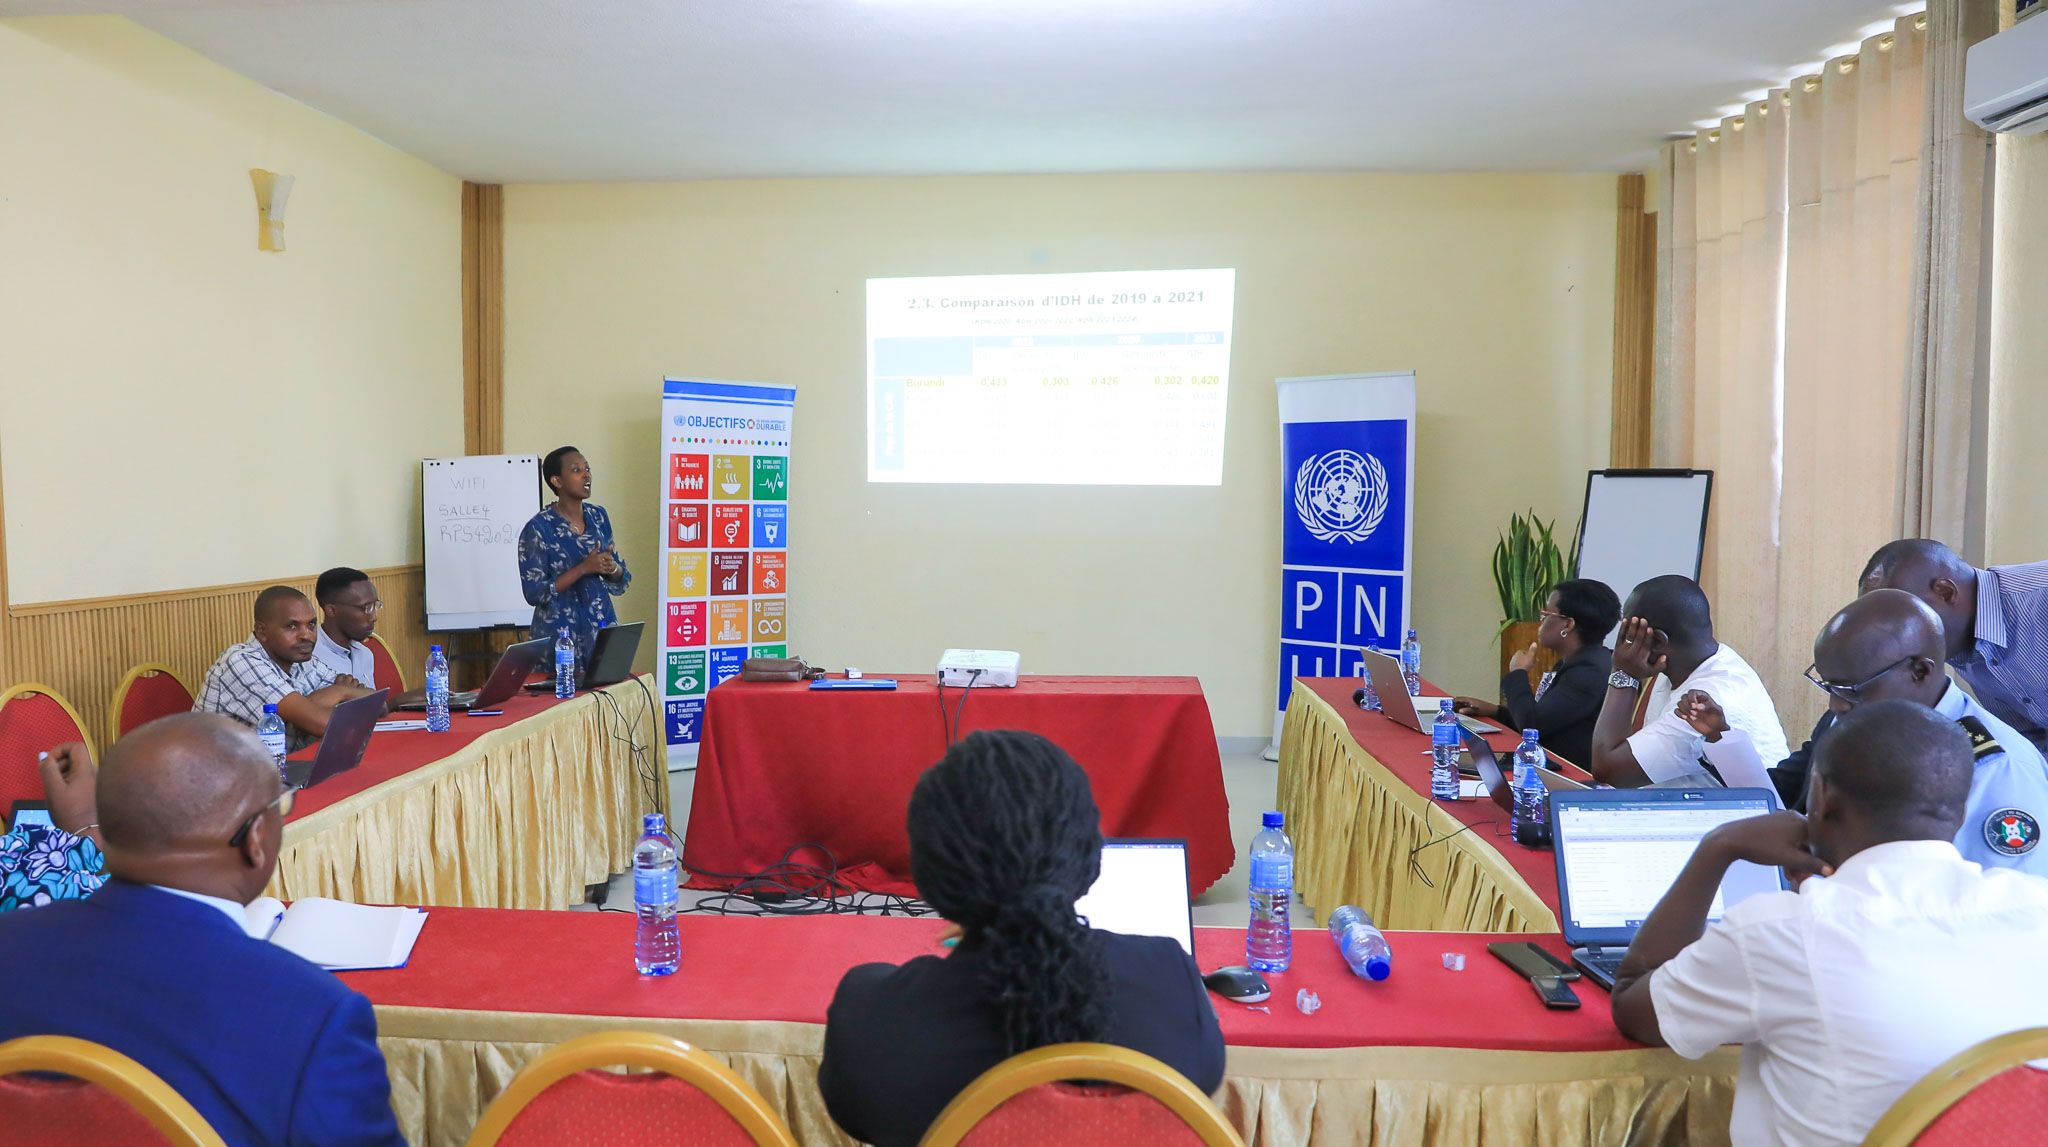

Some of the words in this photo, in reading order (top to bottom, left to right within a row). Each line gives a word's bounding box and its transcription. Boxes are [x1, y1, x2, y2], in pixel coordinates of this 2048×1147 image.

[940, 296, 1035, 310] Comparaison
[1042, 295, 1081, 307] d'IDH
[1088, 294, 1104, 305] de
[1111, 293, 1147, 305] 2019
[1168, 291, 1205, 303] 2021
[906, 378, 945, 388] Burundi
[1154, 375, 1183, 387] 0,302
[1191, 375, 1220, 386] 0,420
[687, 415, 746, 429] OBJECTIFS
[756, 422, 787, 431] DURABLE
[674, 457, 679, 468] 1
[716, 458, 721, 469] 2
[756, 459, 761, 470] 3
[450, 477, 486, 490] WIFI
[673, 507, 679, 518] 4
[716, 507, 721, 518] 5
[756, 508, 761, 518] 6
[672, 555, 677, 565] 7
[714, 555, 719, 565] 8
[755, 555, 761, 565] 9
[669, 605, 678, 616] 10
[713, 604, 719, 614] 11
[754, 602, 761, 613] 12
[711, 651, 720, 662] 14
[754, 649, 761, 659] 15
[668, 655, 678, 665] 13
[667, 703, 677, 714] 16
